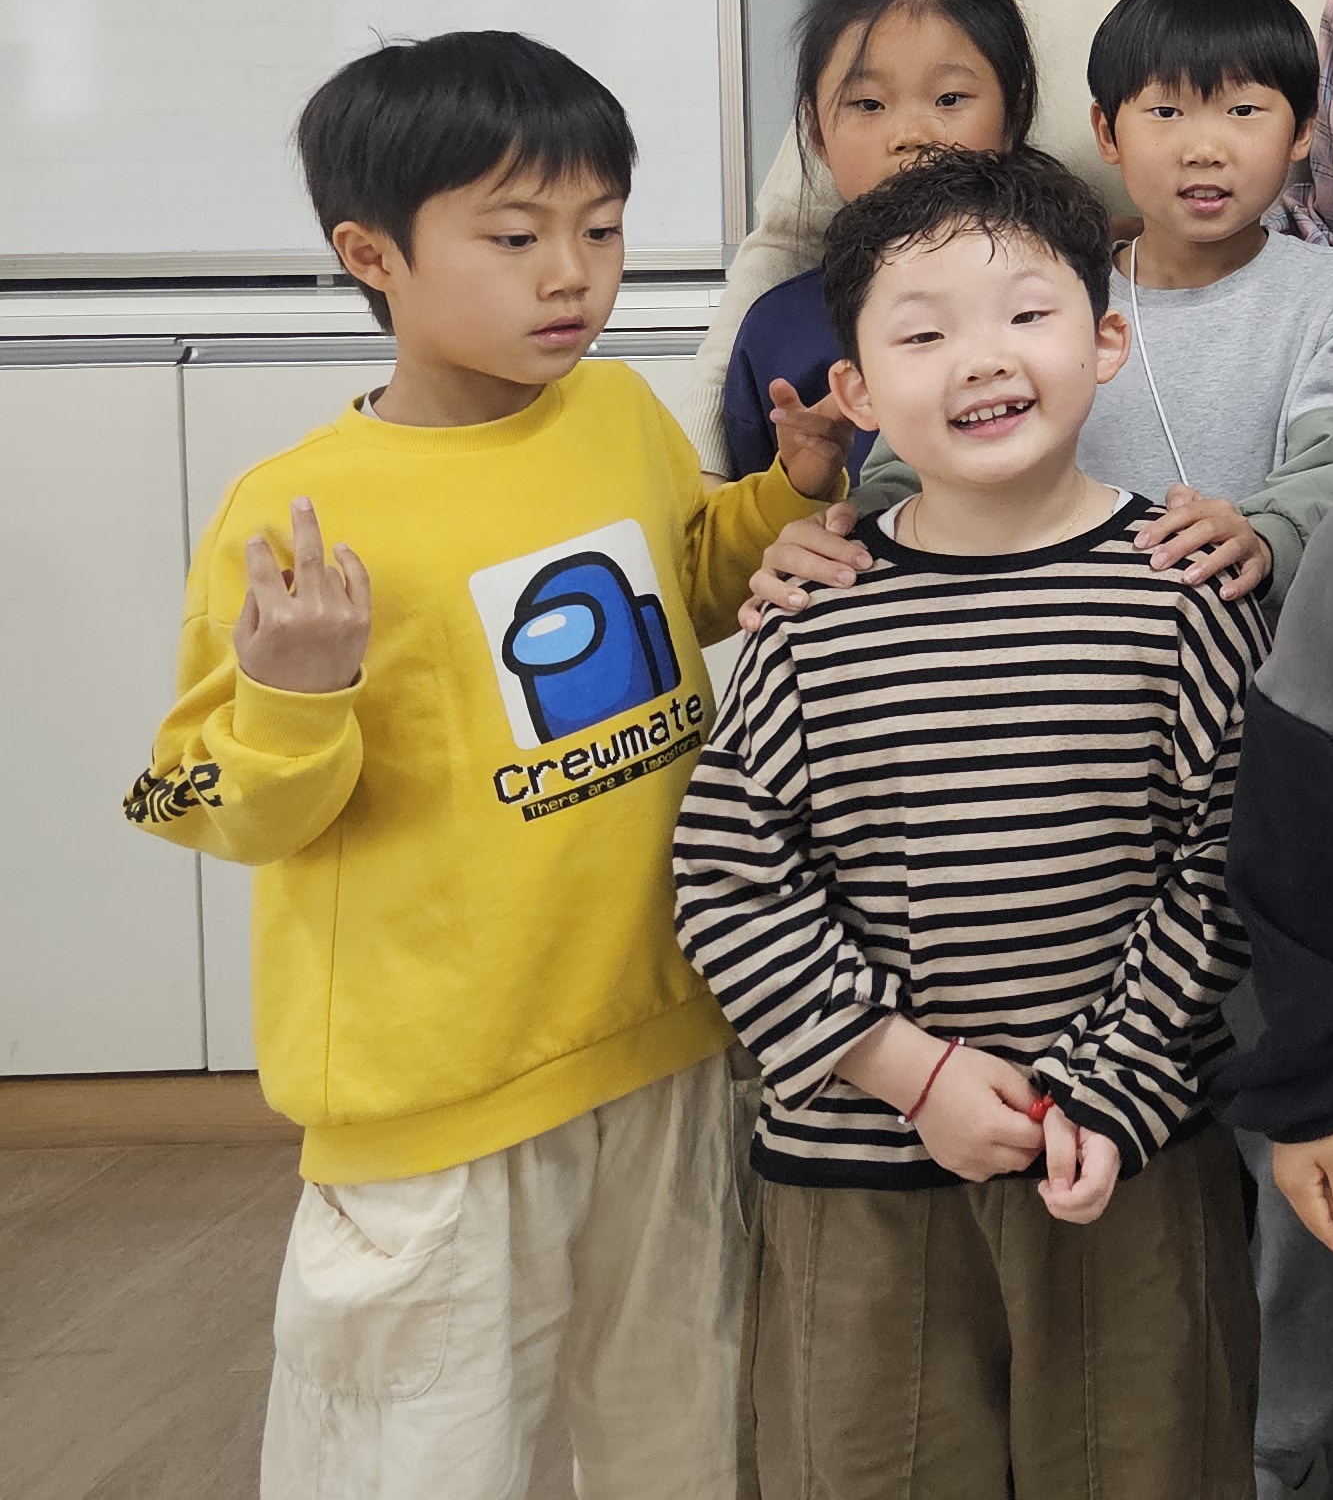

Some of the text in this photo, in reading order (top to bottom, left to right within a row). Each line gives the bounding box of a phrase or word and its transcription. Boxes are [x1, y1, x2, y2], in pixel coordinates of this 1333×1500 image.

[493, 694, 705, 805] Crewmate
[526, 791, 580, 818] There
[588, 777, 616, 797] are
[623, 768, 634, 781] 2
